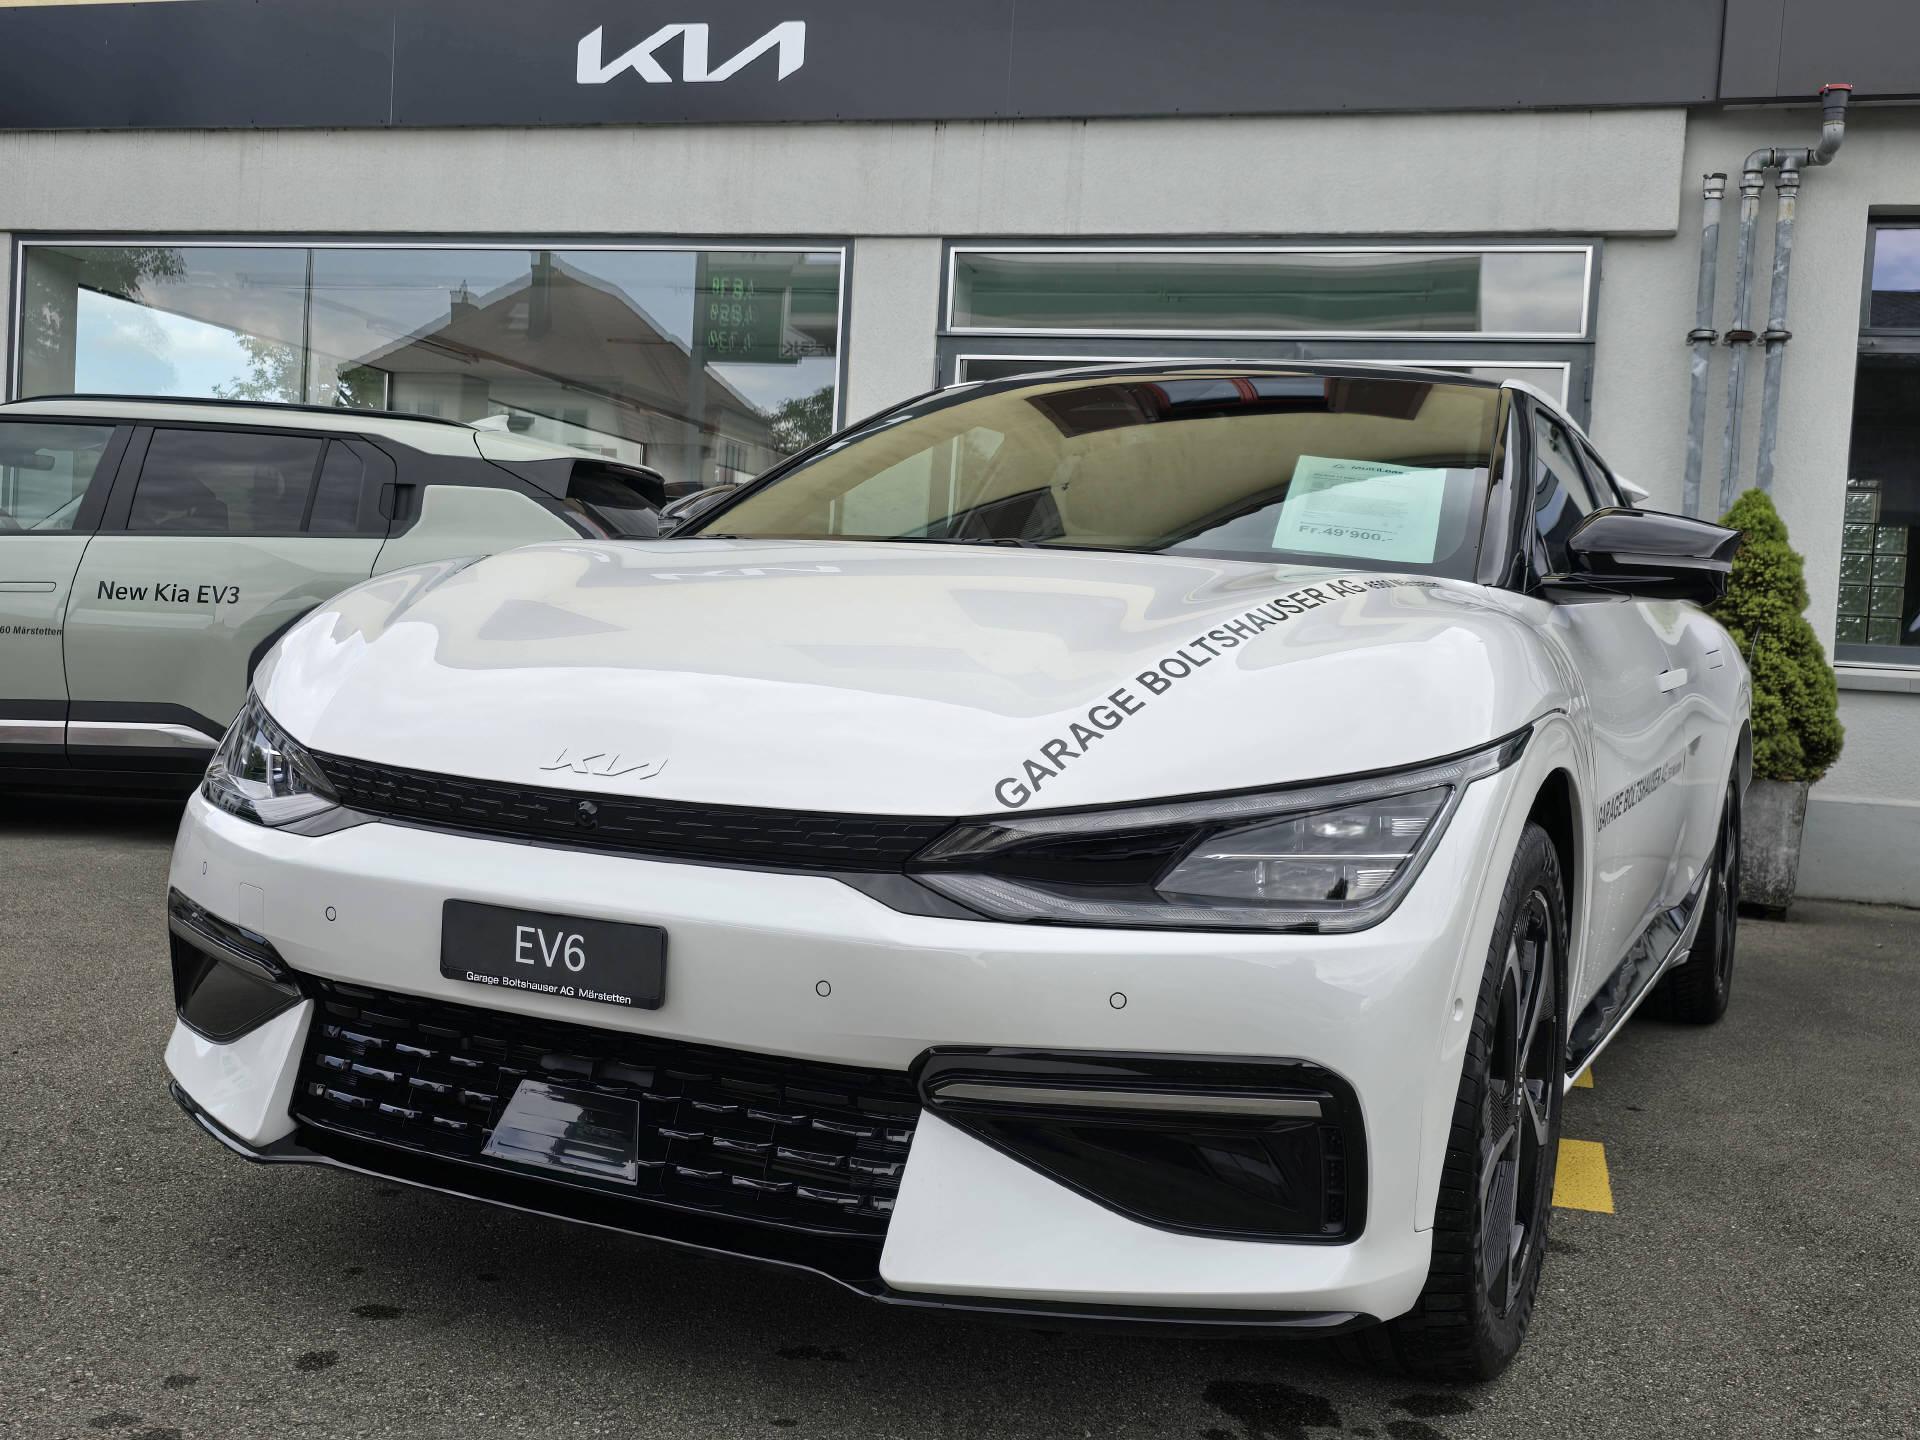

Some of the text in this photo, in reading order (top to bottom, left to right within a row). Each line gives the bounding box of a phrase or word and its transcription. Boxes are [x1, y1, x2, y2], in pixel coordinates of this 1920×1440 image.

[577, 21, 806, 84] KIA
[97, 580, 240, 604] New Kia EV3
[12, 625, 63, 637] Märstetten
[993, 687, 1147, 809] GARAGE
[1135, 587, 1334, 696] BOLTSHAUSER
[1326, 579, 1367, 598] AG
[515, 925, 586, 972] EV6
[466, 971, 632, 1005] Garage Boltshauser AG Märstetten
